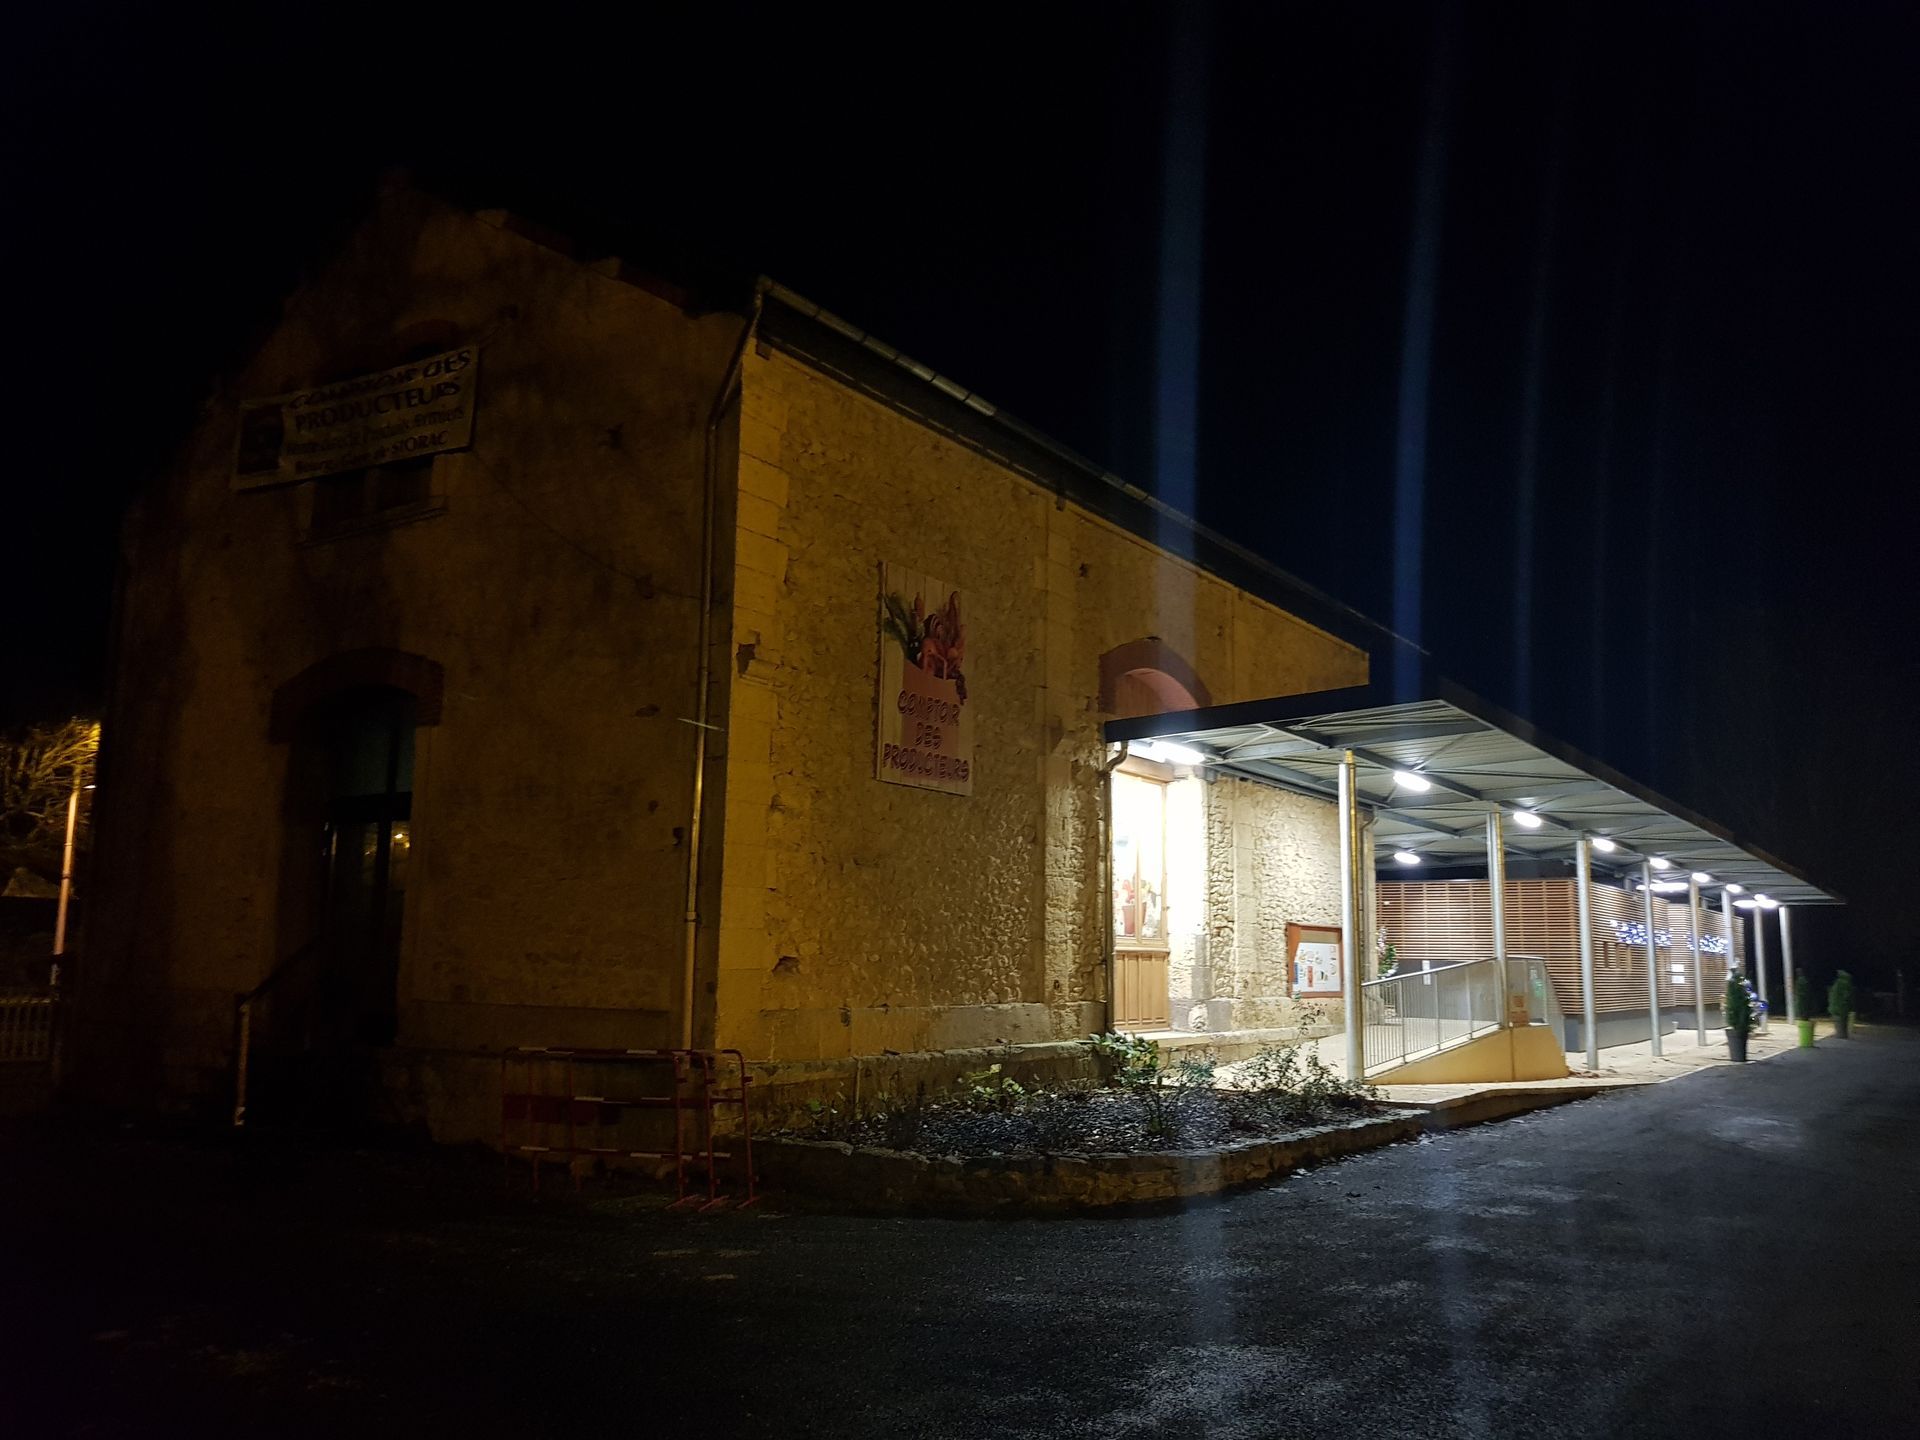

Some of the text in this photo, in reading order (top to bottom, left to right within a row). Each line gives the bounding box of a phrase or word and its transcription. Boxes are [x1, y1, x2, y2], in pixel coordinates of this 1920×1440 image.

[423, 349, 471, 378] DES
[295, 377, 461, 431] PRODUCTEURS
[914, 721, 943, 750] DES
